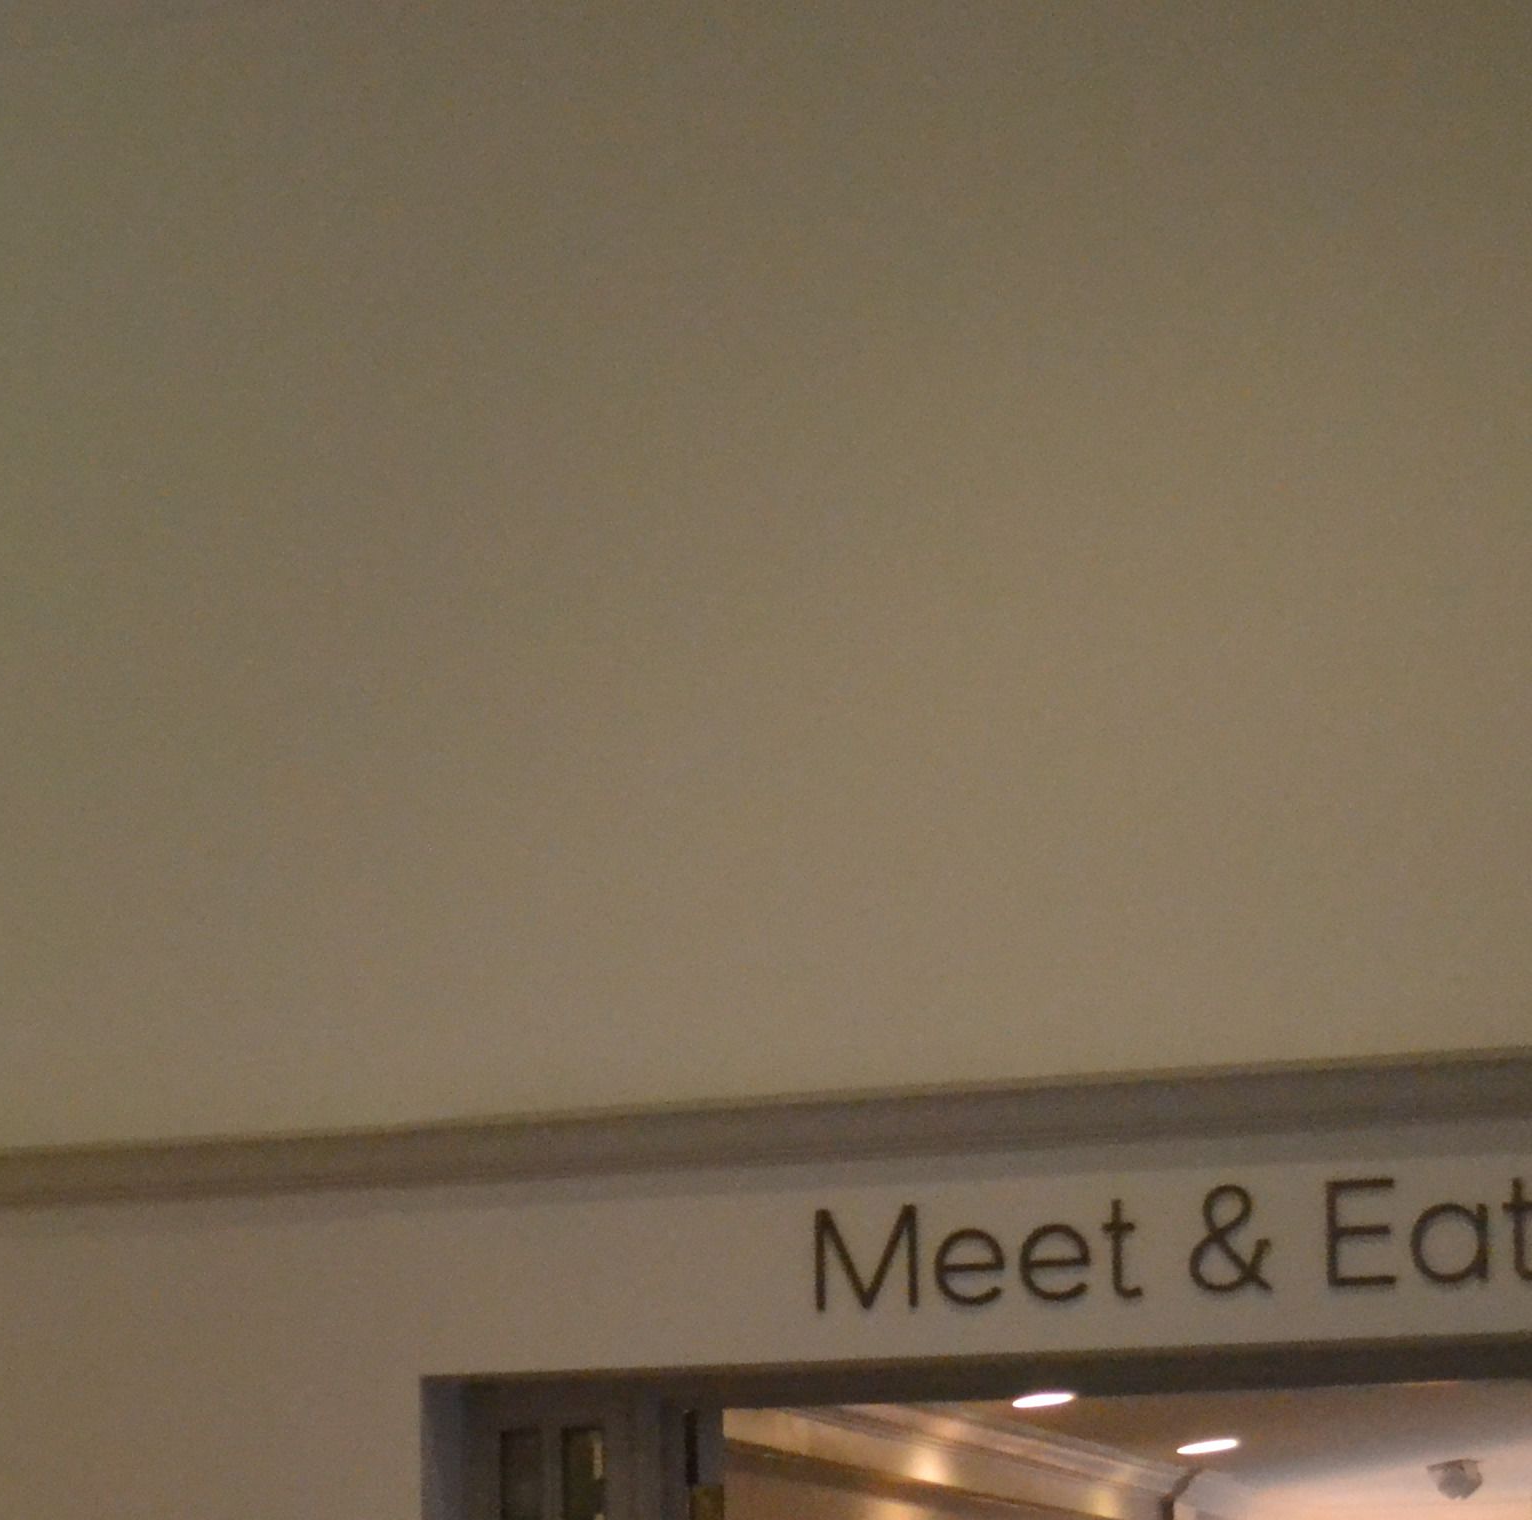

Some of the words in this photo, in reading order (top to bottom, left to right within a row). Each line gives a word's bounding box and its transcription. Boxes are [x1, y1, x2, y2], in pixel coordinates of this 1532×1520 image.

[813, 1198, 1144, 1314] Meet
[1188, 1183, 1273, 1293] &
[1324, 1177, 1532, 1288] Eat
